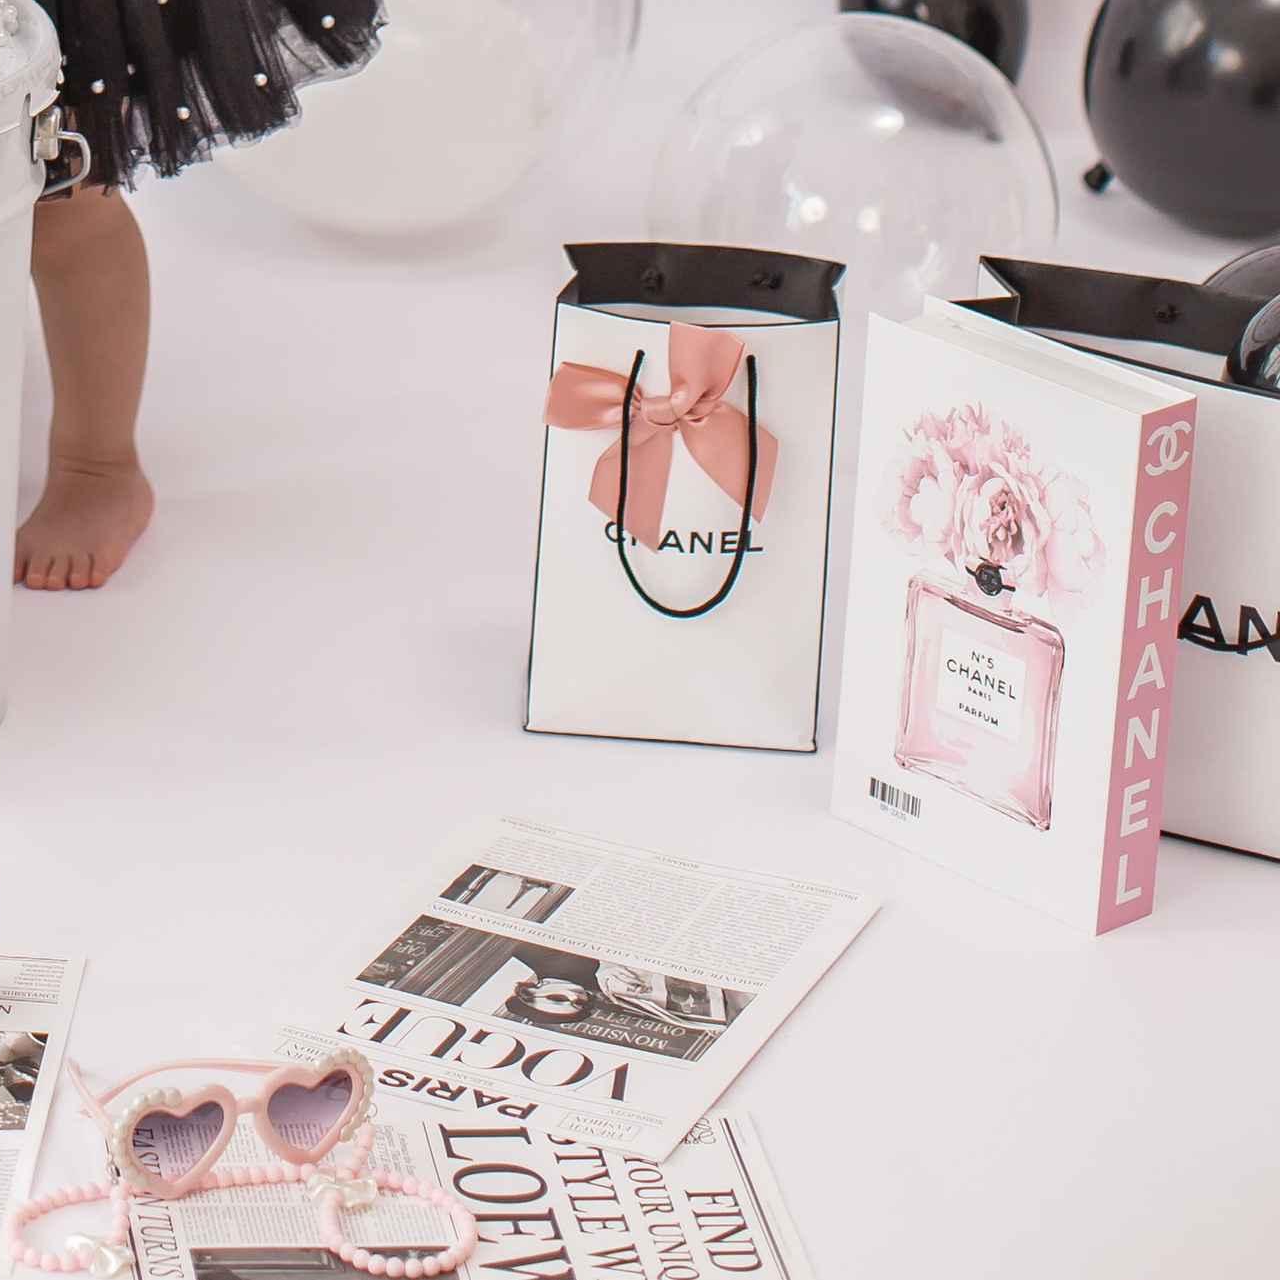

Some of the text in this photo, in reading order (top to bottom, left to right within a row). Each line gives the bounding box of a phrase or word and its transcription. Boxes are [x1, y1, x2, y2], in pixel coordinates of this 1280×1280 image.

[605, 521, 763, 553] CANEL
[946, 658, 1016, 700] CHANEL
[968, 686, 992, 702] PARIS
[959, 702, 999, 727] PARFUM
[1115, 501, 1179, 905] CHANEL
[1, 990, 58, 999] SUBSTANCE
[337, 998, 632, 1103] VOGUE
[378, 1069, 539, 1121] PARIS
[569, 1123, 623, 1140] FRENCH
[575, 1116, 632, 1132] FASHION
[132, 1127, 185, 1279] FASN TURNS
[684, 1187, 763, 1272] FIND
